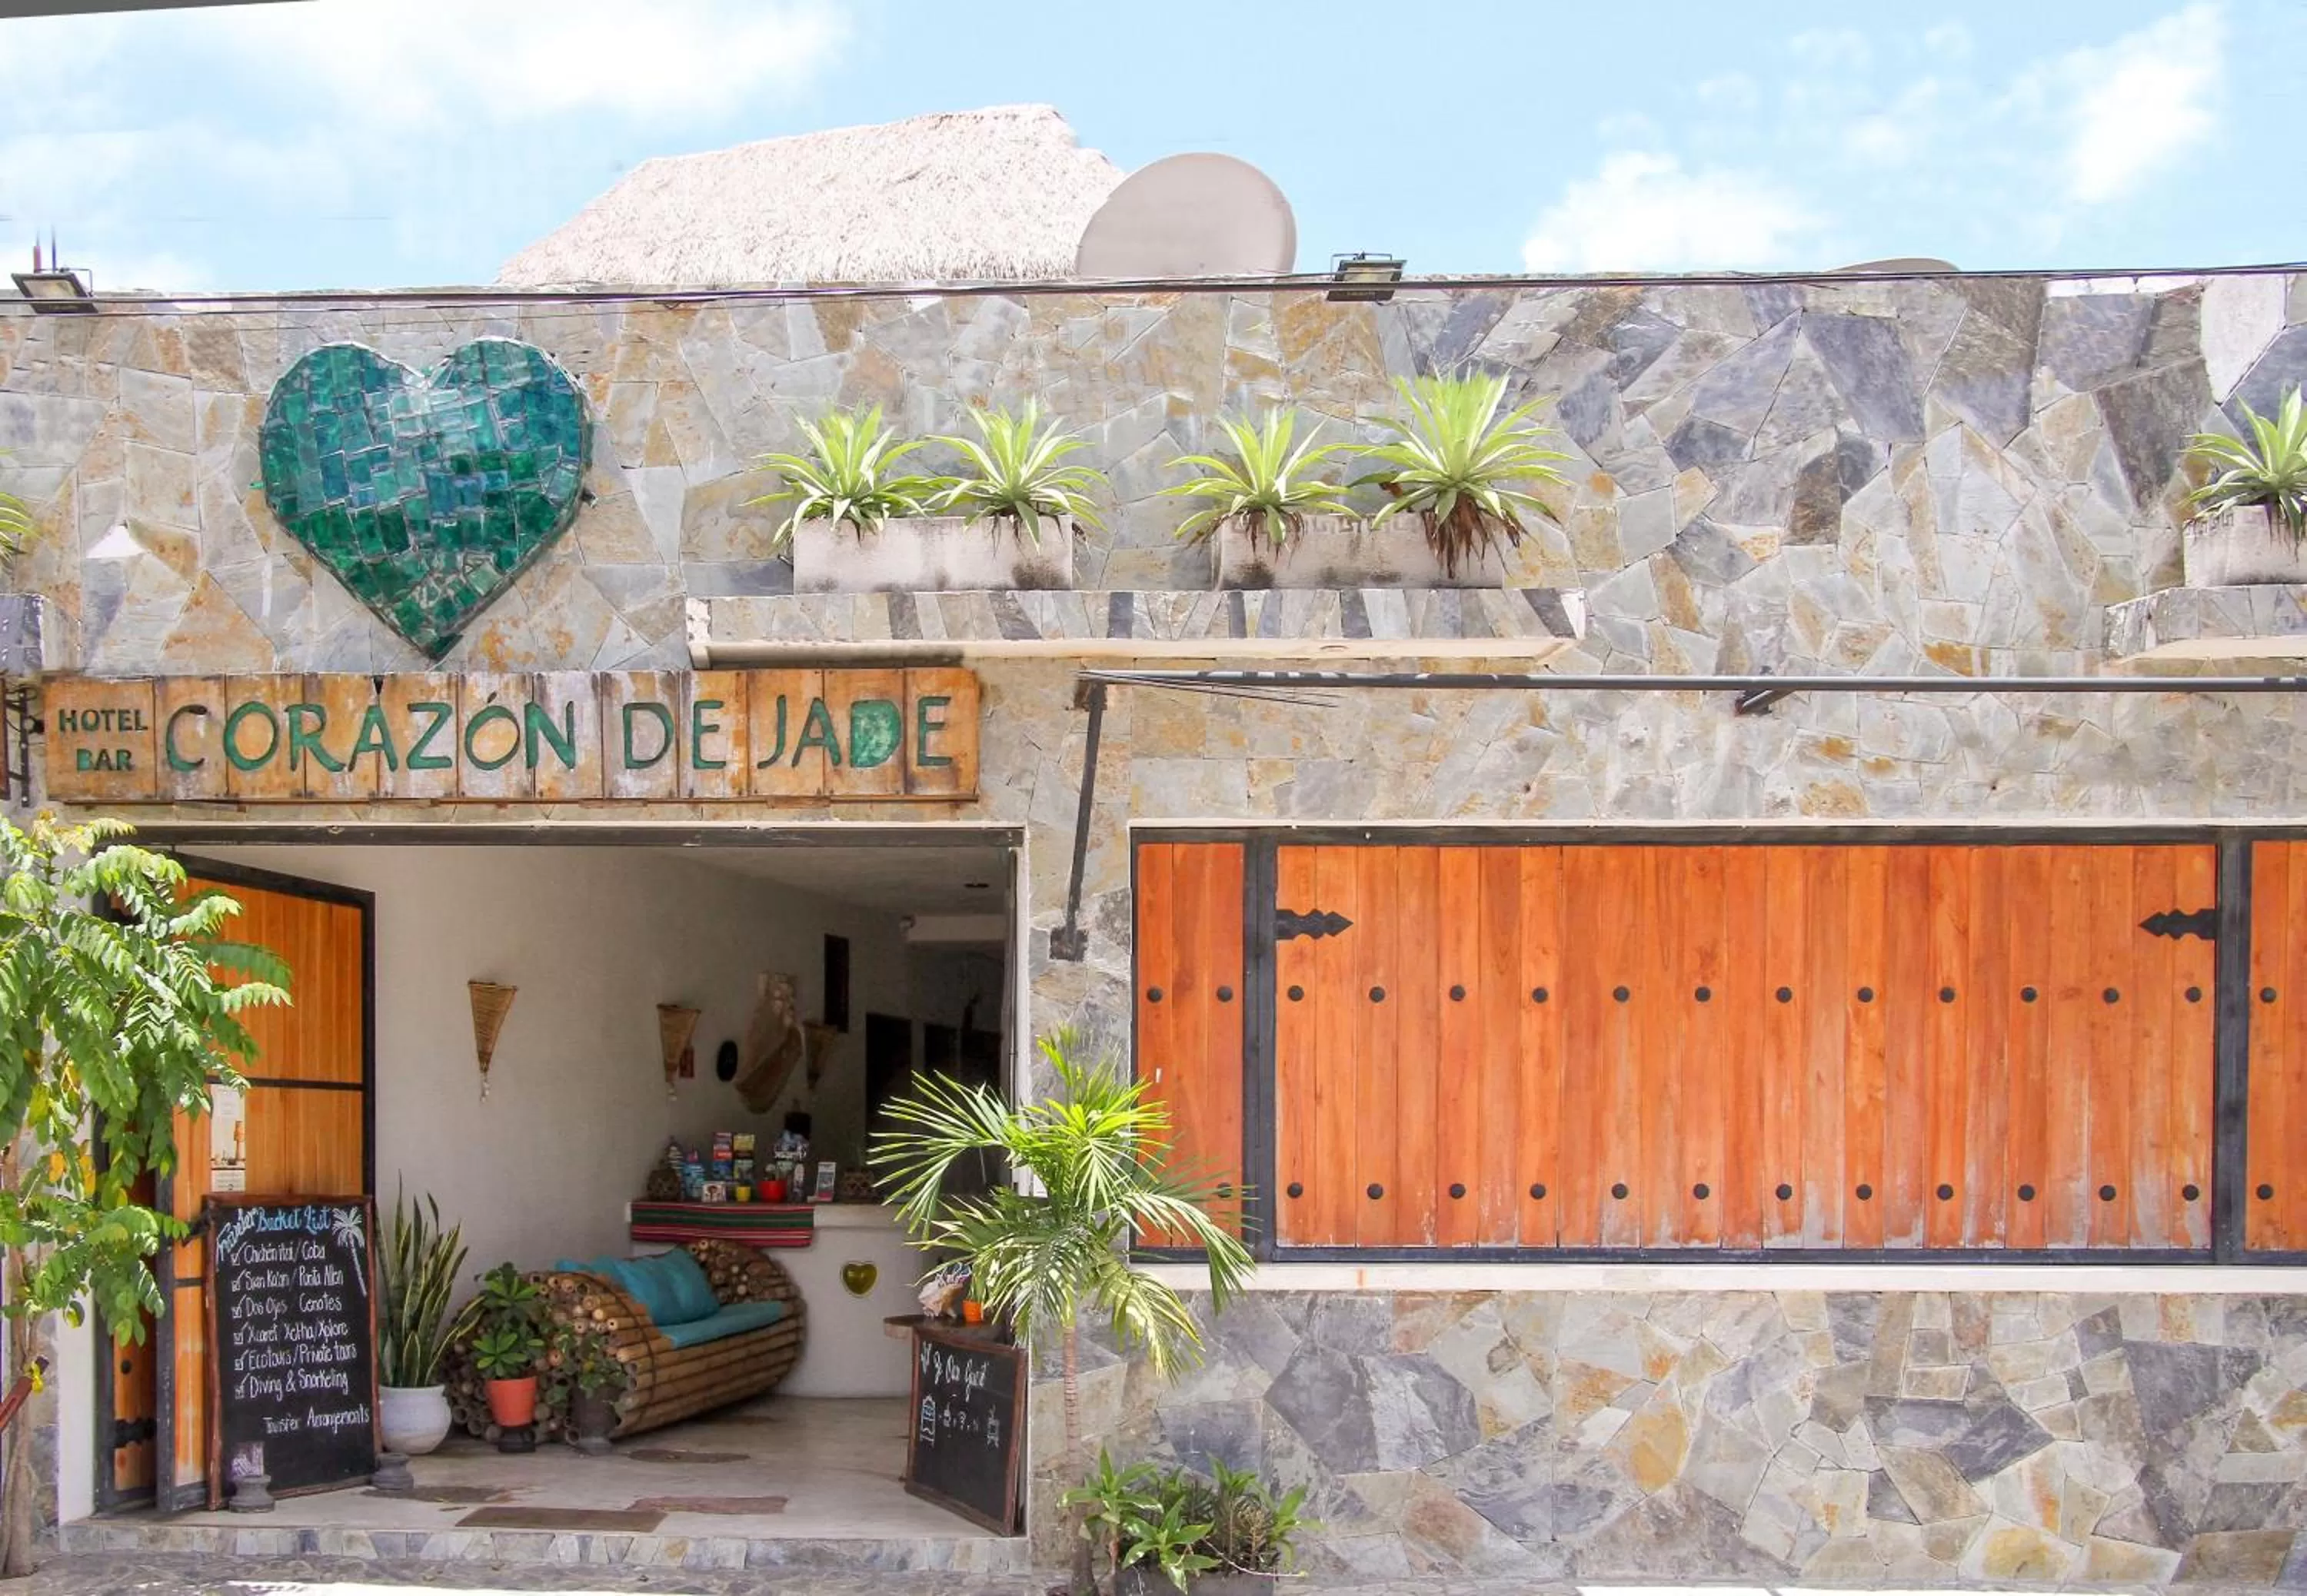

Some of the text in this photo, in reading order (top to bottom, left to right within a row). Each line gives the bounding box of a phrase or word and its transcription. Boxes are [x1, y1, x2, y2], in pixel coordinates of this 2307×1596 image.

[58, 708, 148, 733] HOTEL
[165, 692, 954, 773] CORAZÓN DE JADE
[76, 749, 134, 771] BAR
[257, 1206, 302, 1232] Bucket
[305, 1205, 331, 1235] List
[245, 1296, 265, 1317] Dos
[299, 1292, 343, 1313] Cenotes
[334, 1340, 358, 1362] tours
[250, 1367, 349, 1402] Diving & Snorkeling
